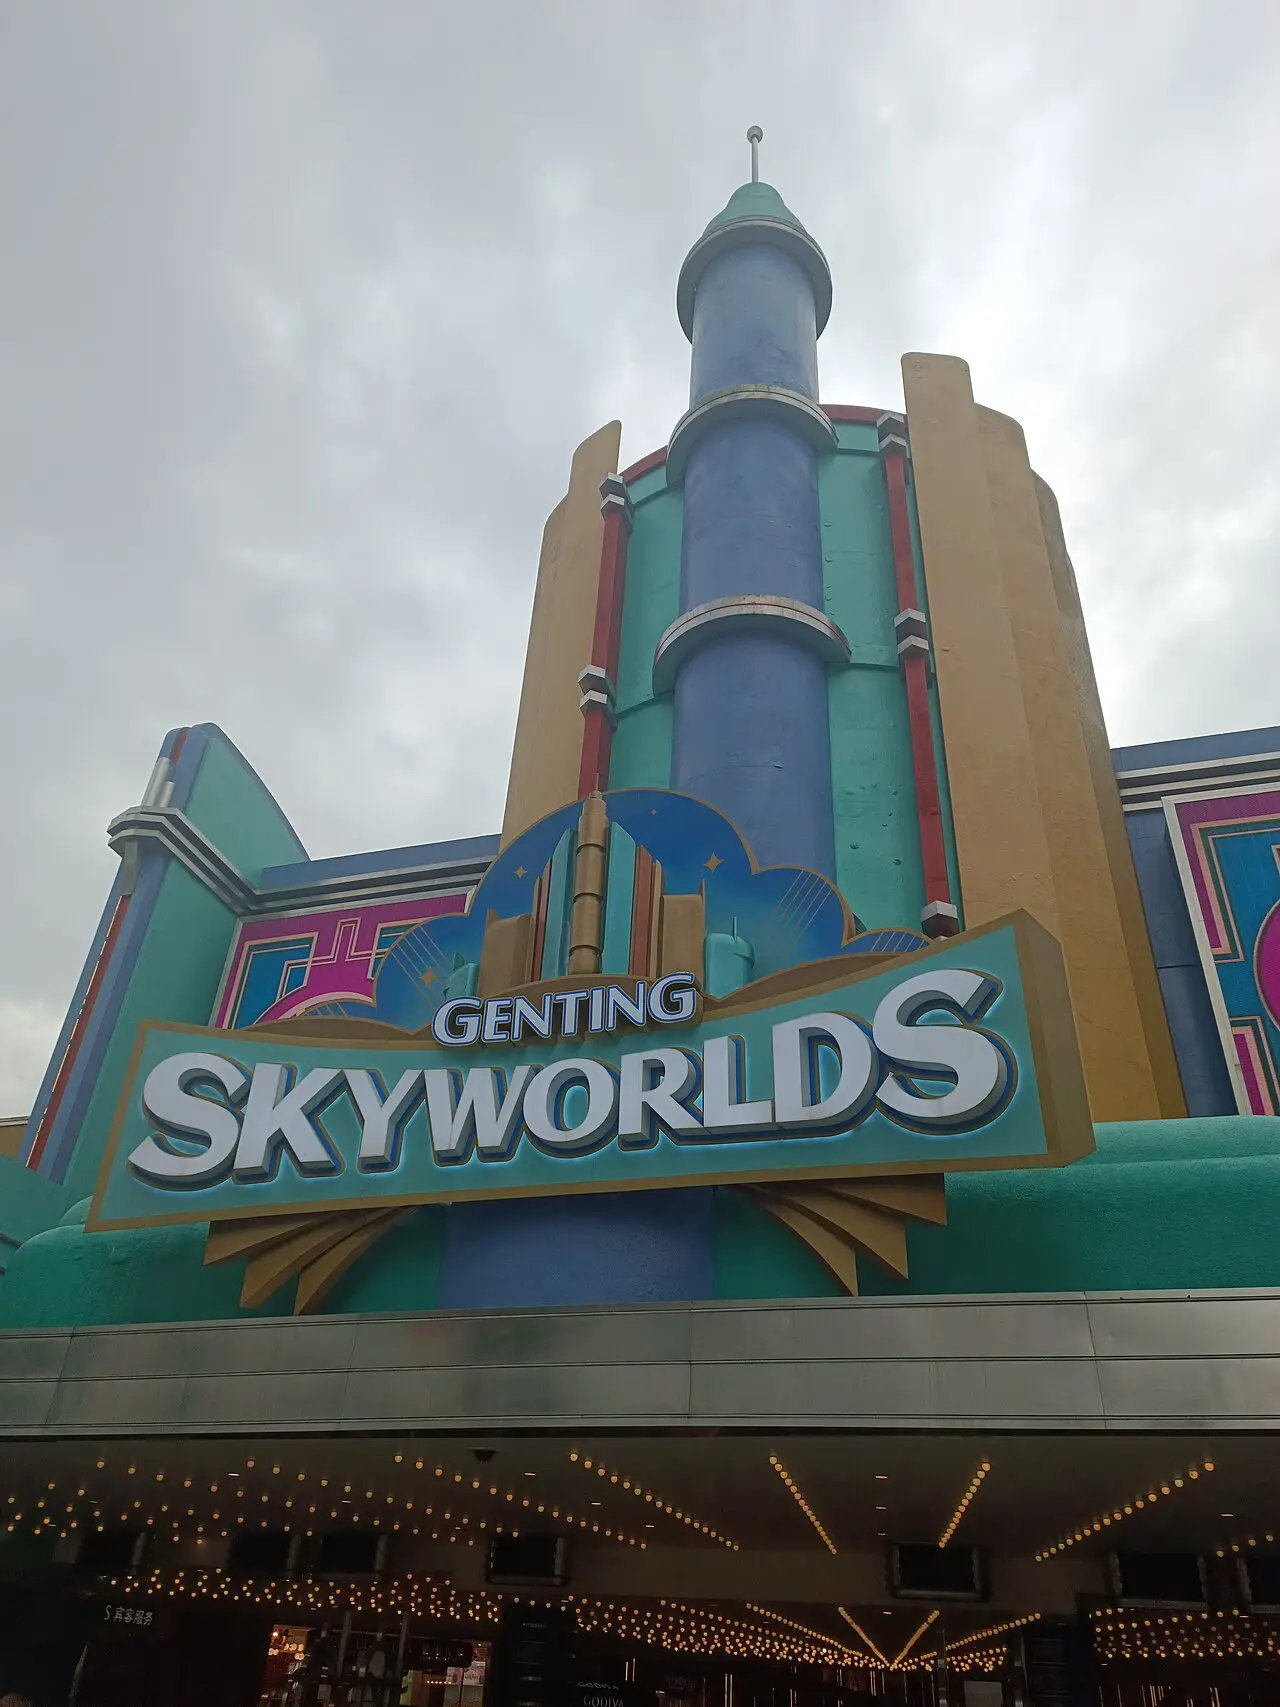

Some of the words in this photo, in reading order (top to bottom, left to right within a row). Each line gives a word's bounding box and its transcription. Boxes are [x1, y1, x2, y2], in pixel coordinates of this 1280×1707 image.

[432, 971, 697, 1046] GENTING
[127, 969, 1008, 1186] SKYWORLDS
[583, 1695, 625, 1707] GODIVA
